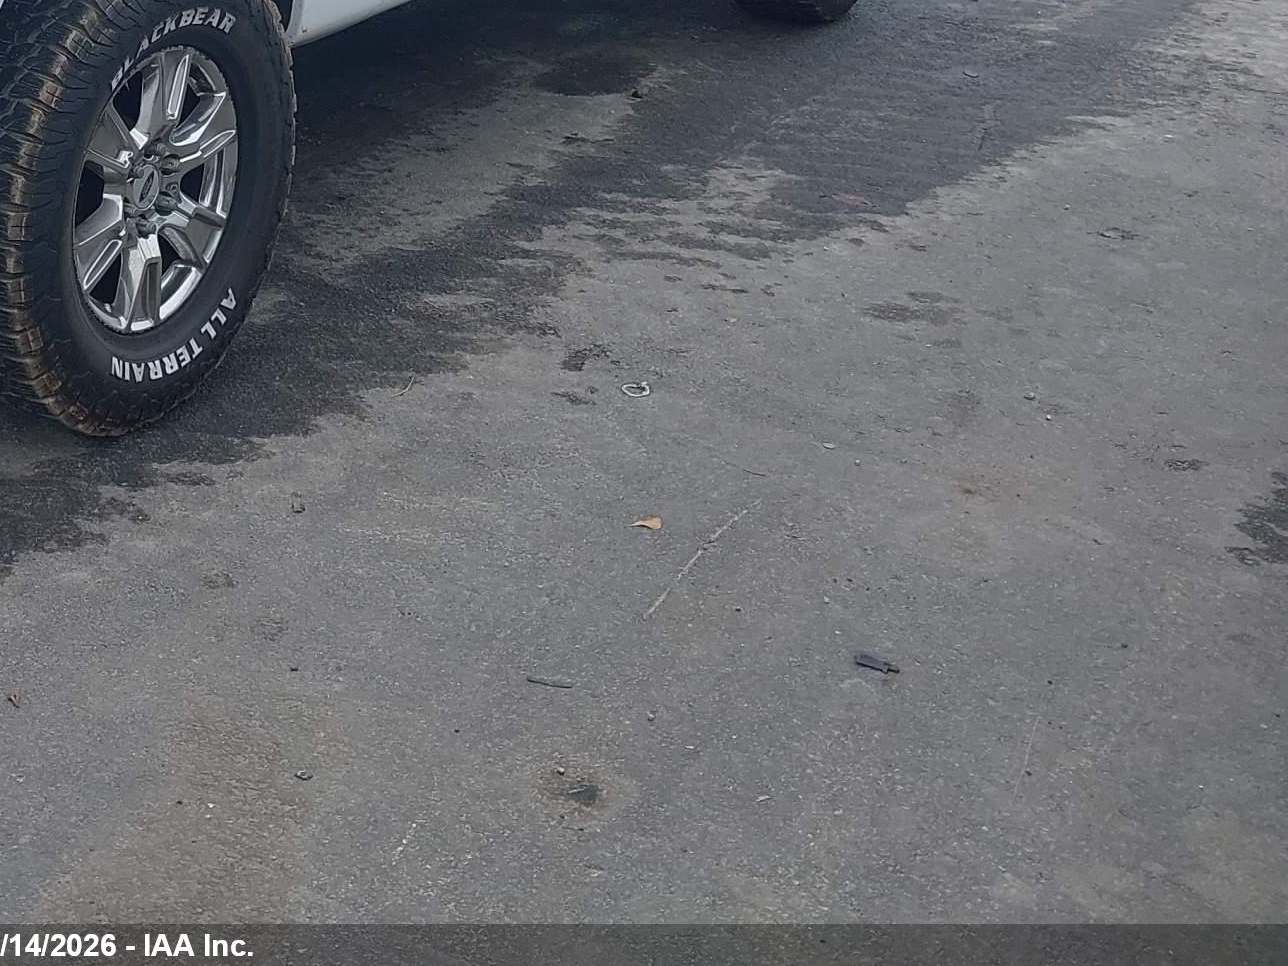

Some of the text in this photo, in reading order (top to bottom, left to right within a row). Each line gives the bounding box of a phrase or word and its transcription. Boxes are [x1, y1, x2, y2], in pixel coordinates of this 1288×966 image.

[111, 6, 237, 91] BLACKBEAR
[112, 287, 237, 383] ALL TERRAIN
